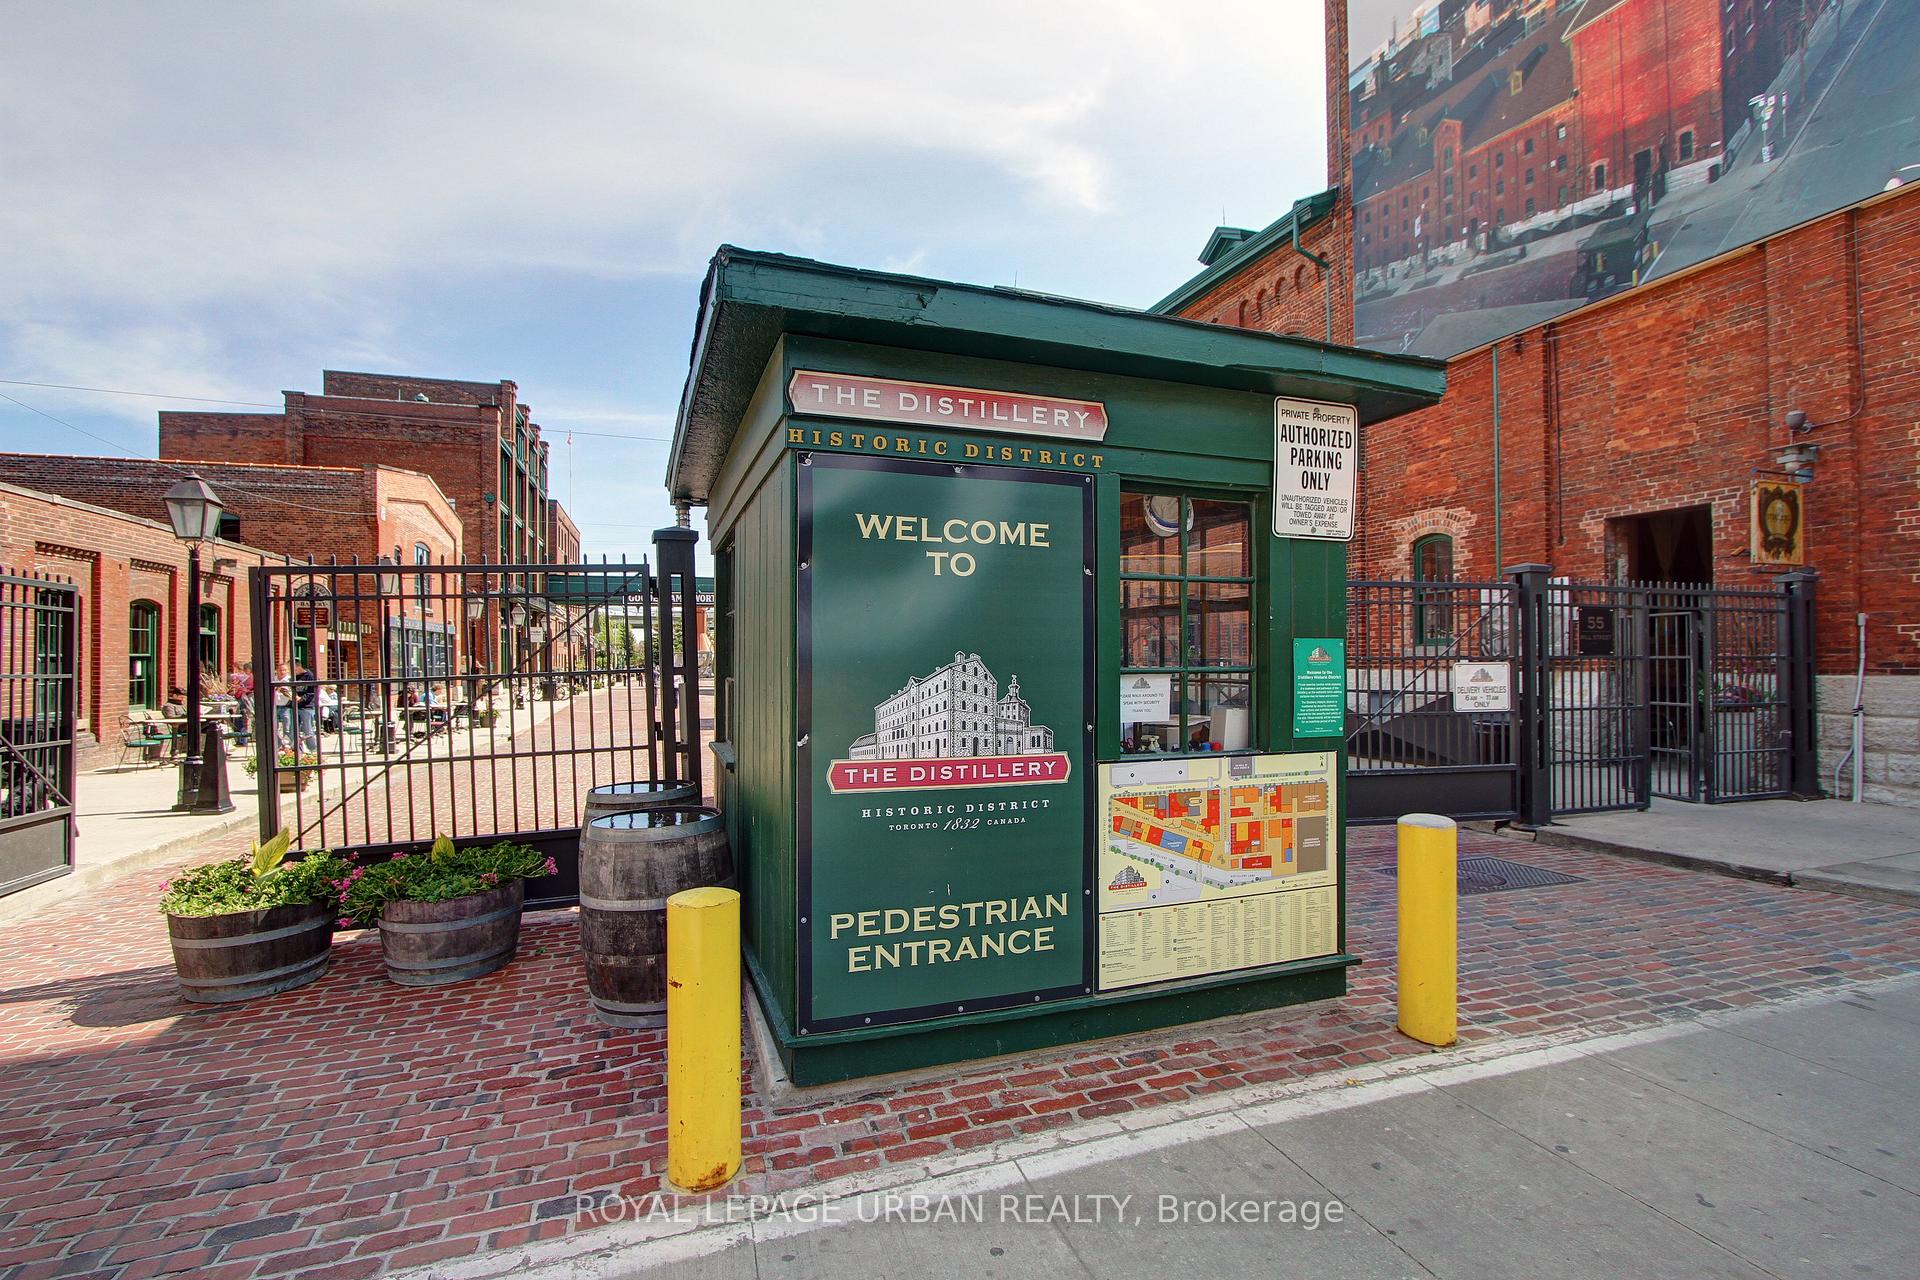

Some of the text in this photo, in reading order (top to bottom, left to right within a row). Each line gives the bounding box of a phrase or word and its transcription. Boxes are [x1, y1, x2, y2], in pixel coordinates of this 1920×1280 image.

[811, 383, 1090, 429] THE DISTILLERY
[1281, 408, 1350, 425] PRIVATE PROPERTY
[1280, 424, 1352, 449] AUTHORIZED
[788, 428, 1104, 468] HISTORIC DISTRICT
[1290, 447, 1342, 470] PARKING
[1301, 470, 1331, 491] ONLY
[1281, 494, 1348, 506] UNAUTHORIZED VEHICLES
[1304, 503, 1325, 512] TAGGED
[1289, 518, 1338, 528] OWNER'S EXPENSE
[1293, 510, 1312, 518] TOWED
[855, 513, 1050, 548] WELCOME
[926, 550, 976, 577] TO
[1587, 616, 1605, 629] 55
[1457, 685, 1507, 694] DELIVERY VEHICLES
[845, 761, 1056, 784] THE DISTILLERY
[861, 799, 1050, 818] HISTORIC DISTRICT
[889, 817, 1026, 831] TORONTO 1832 CANADA
[830, 892, 1068, 940] PEDESTRIAN
[848, 926, 1054, 972] ENTRANCE
